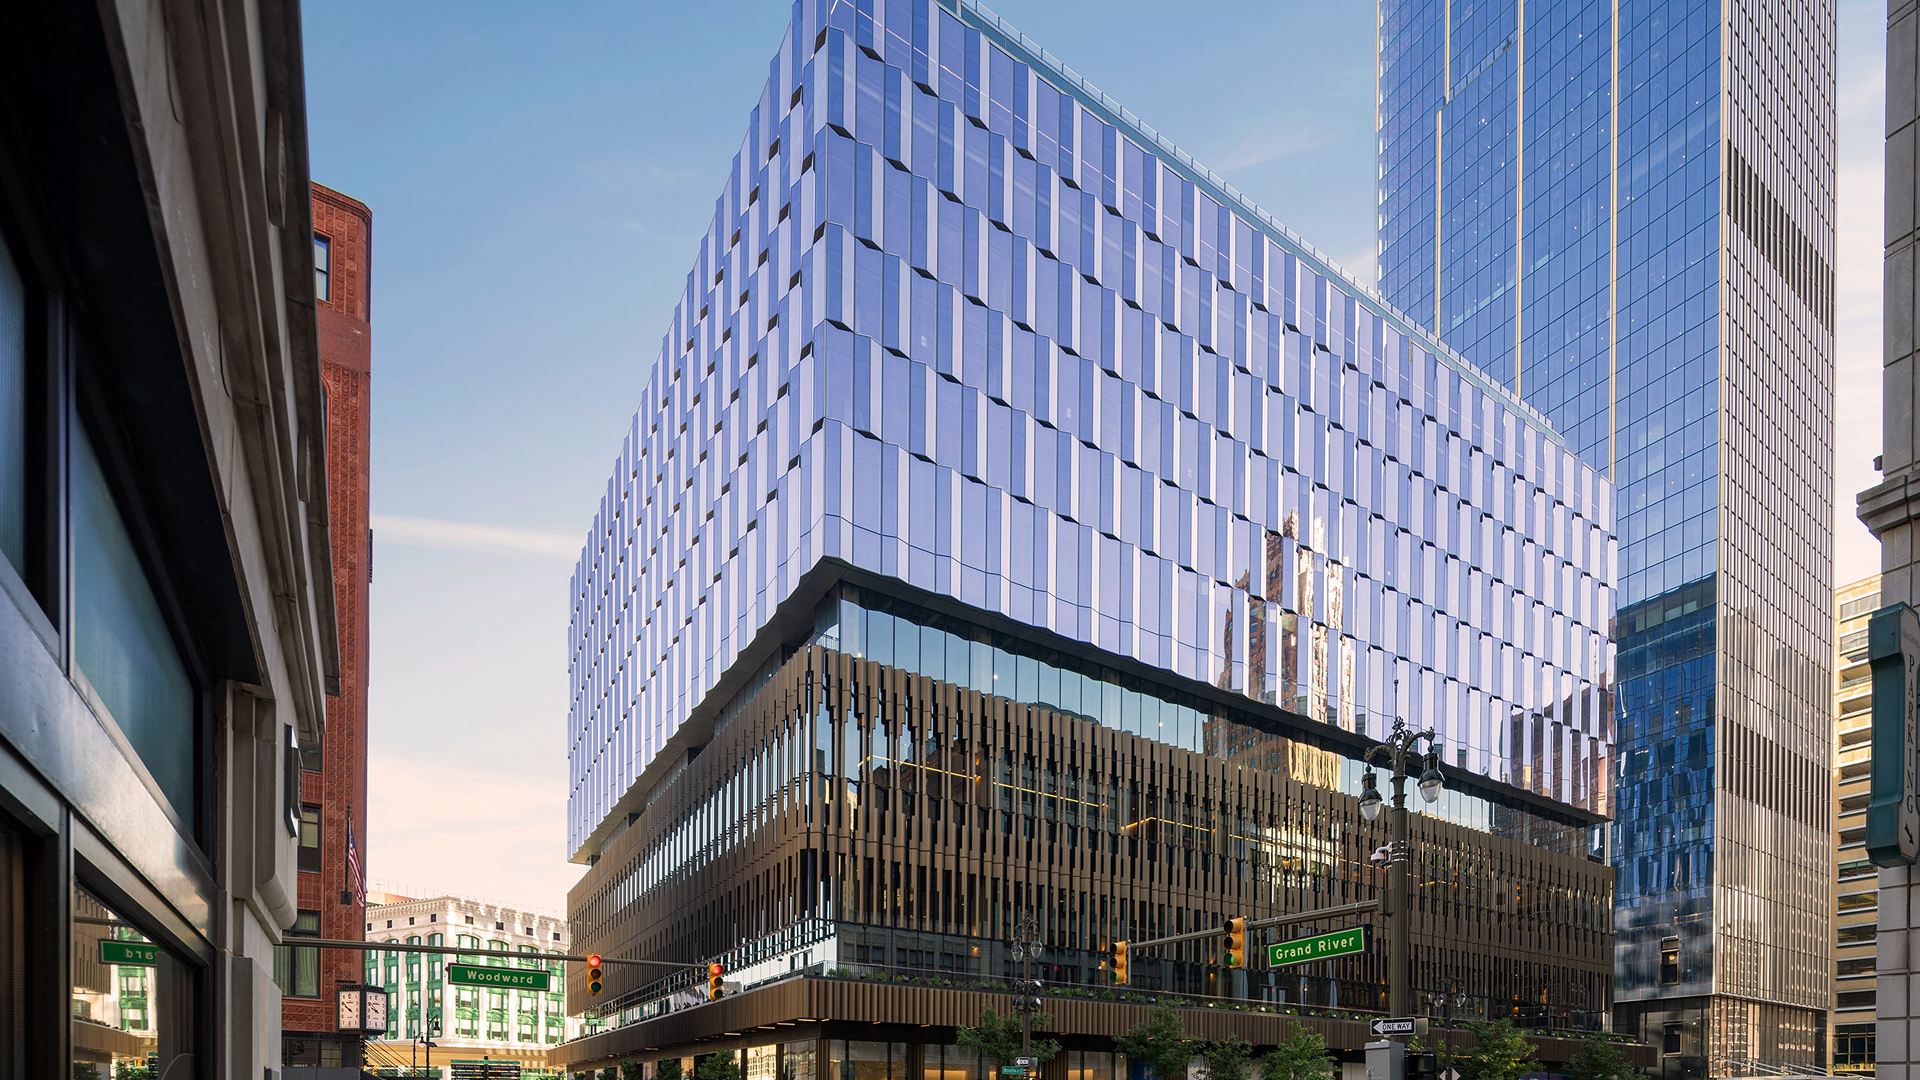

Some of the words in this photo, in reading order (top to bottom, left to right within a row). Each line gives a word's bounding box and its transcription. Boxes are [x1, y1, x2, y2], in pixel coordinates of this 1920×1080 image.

[1906, 653, 1915, 814] PARKING
[1275, 943, 1312, 960] Grand
[1318, 936, 1355, 952] River
[467, 970, 533, 984] Woodward
[1397, 1022, 1410, 1030] WAY
